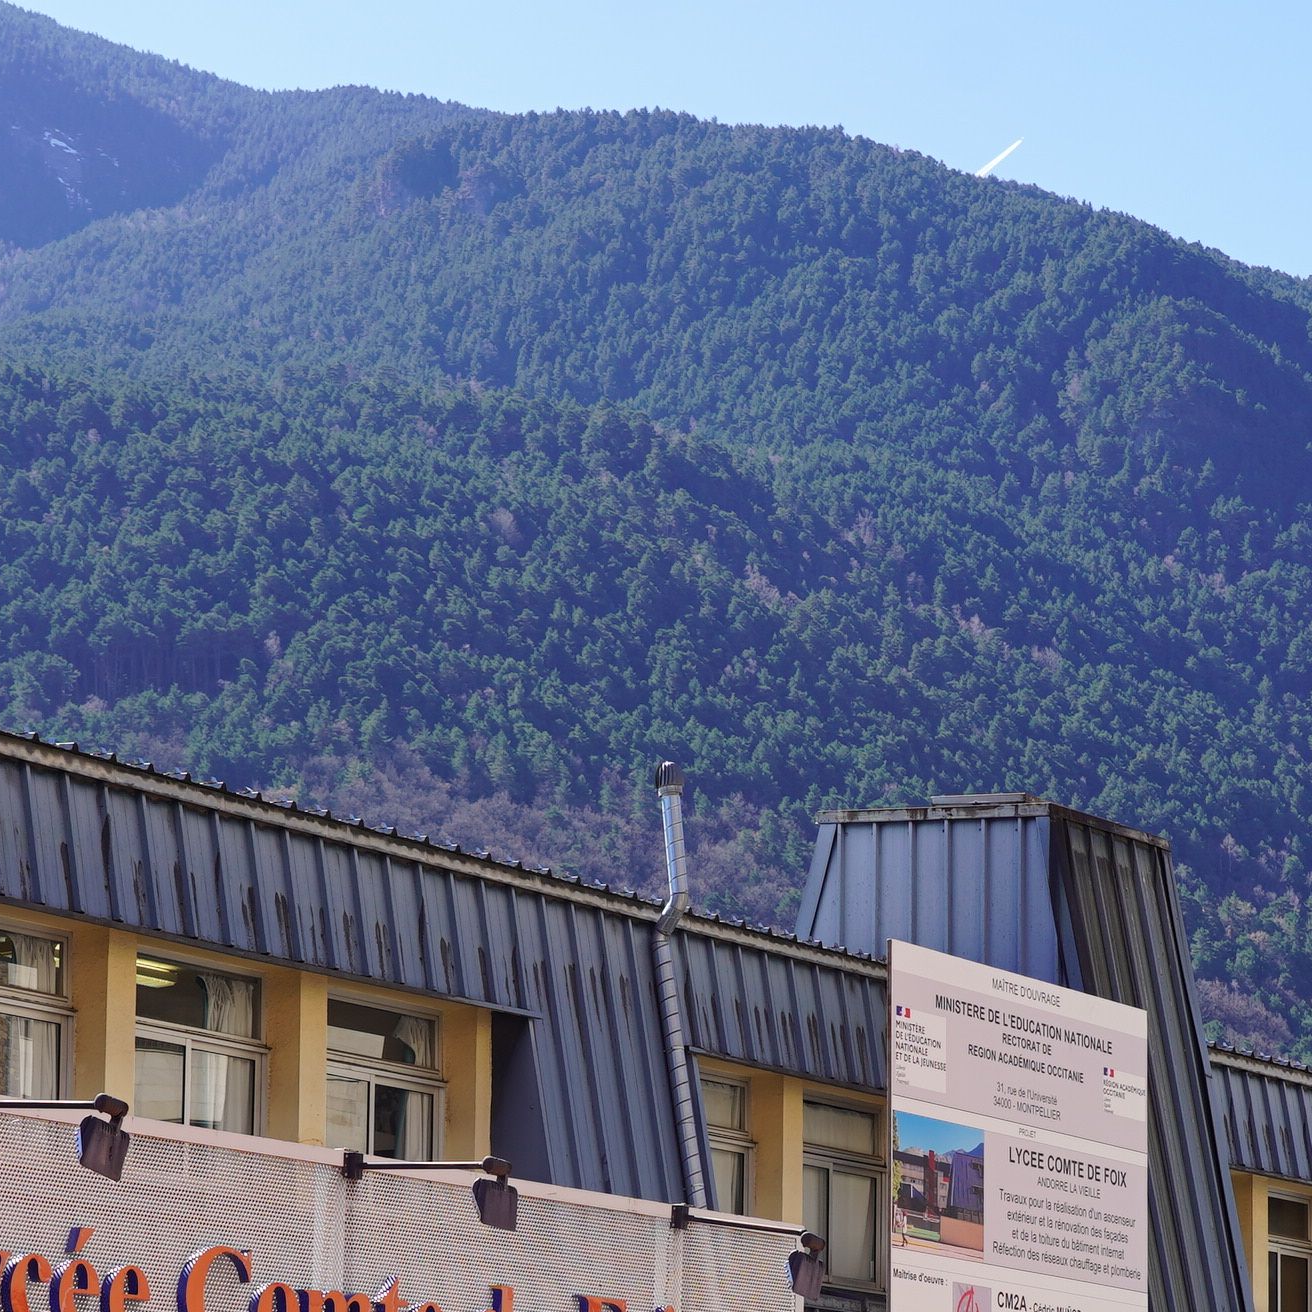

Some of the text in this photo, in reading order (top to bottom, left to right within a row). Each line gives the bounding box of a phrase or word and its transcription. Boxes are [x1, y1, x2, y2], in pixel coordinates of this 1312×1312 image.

[992, 978, 1060, 1007] MAÎTRE D'OUVRAGE
[895, 1019, 925, 1034] MINISTÈRE
[935, 994, 1112, 1054] MINISTERE DE L'EDUCATION NATIONALE
[895, 1031, 940, 1049] DE L'ÉDUCATION
[895, 1041, 927, 1056] NATIONALE
[1002, 1033, 1051, 1055] RECTORAT DE
[895, 1051, 946, 1073] ET DE LA JEUNESSE
[968, 1044, 1083, 1083] REGION ACADÉMIQUE OCCITANIE
[993, 1095, 1060, 1121] 34000 MONTPELLIER
[1007, 1087, 1016, 1096] rue
[1018, 1087, 1025, 1098] de
[1027, 1089, 1057, 1106] l'Université
[1009, 1146, 1126, 1187] LYCEE COMTE DE FOIX
[1037, 1176, 1067, 1192] ANDORRE
[1069, 1183, 1077, 1194] LA
[999, 1188, 1135, 1227] Travaux pour la réalisation d'un ascenseur
[1007, 1210, 1128, 1246] extérieur et la rénovation des façades
[1011, 1228, 1124, 1259] et de la toiture du bâtiment internat
[992, 1240, 1141, 1282] Réfection des réseaux chauffage et plomberie
[892, 1268, 943, 1286] Maîtrise d'oeuvre
[997, 1291, 1026, 1311] CM2A
